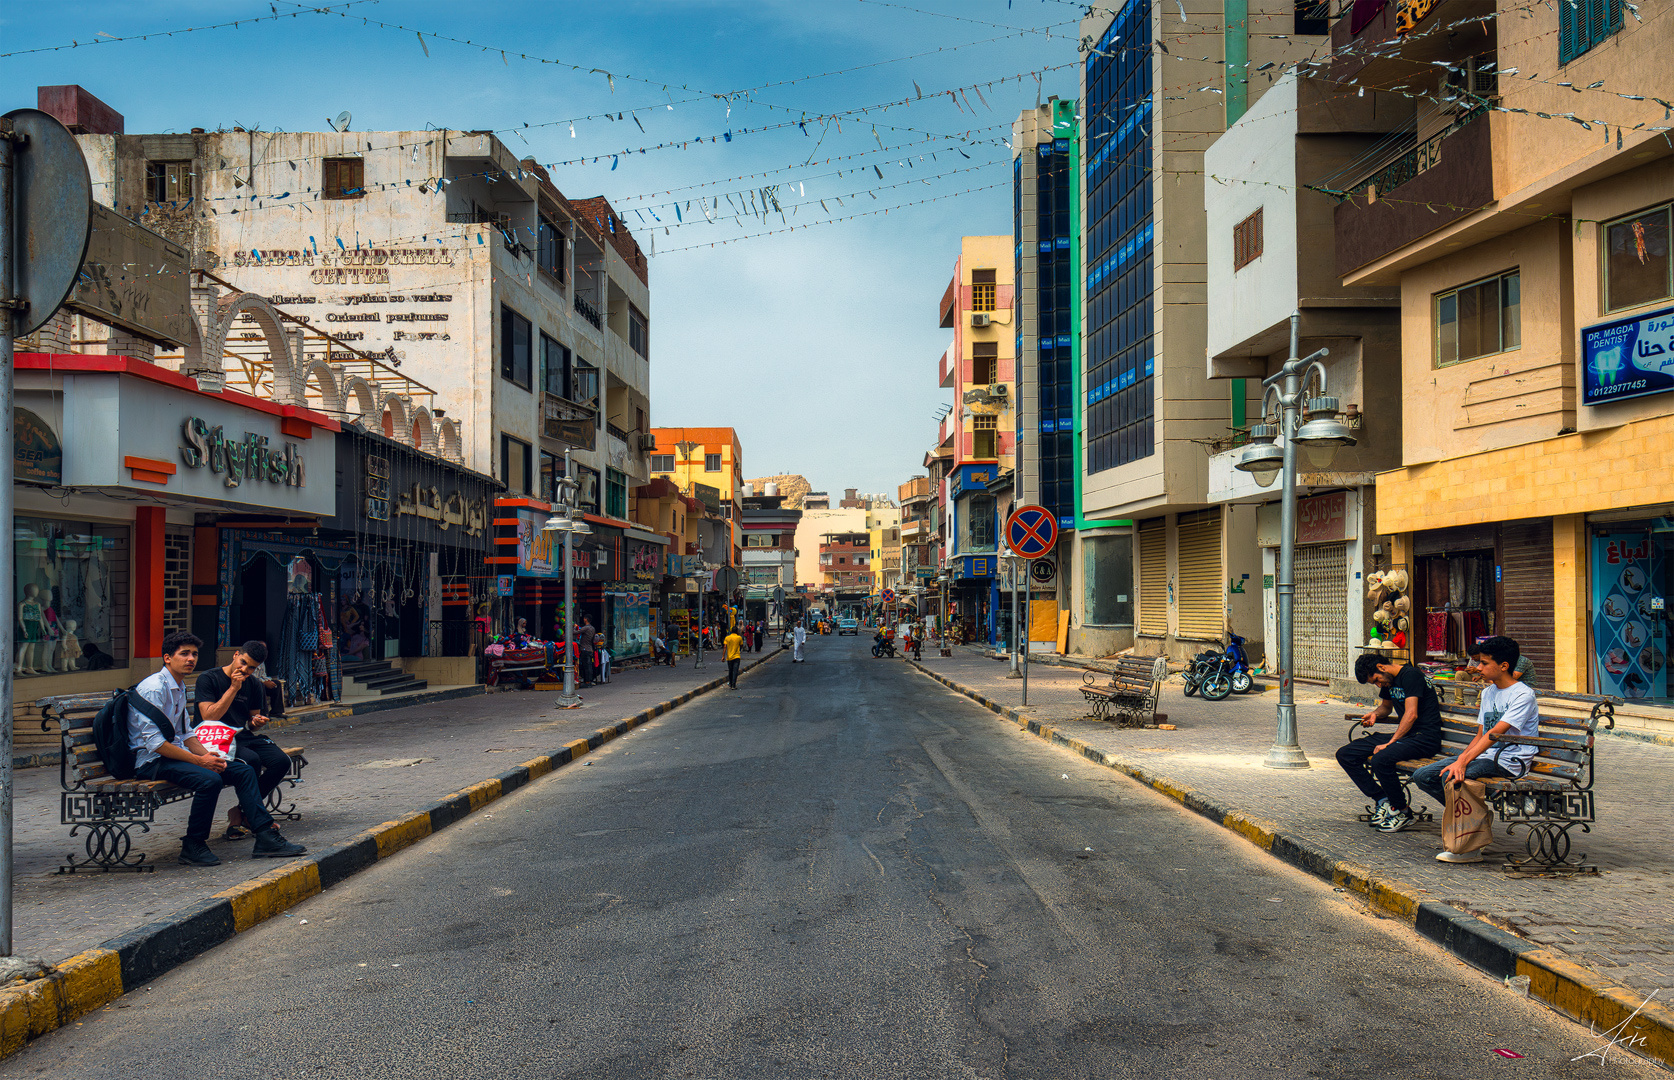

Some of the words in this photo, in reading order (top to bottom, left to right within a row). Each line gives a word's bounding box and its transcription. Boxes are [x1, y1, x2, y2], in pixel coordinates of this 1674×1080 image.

[233, 249, 315, 267] SANDRA
[320, 253, 332, 266] &
[309, 268, 390, 284] CENTER
[325, 312, 381, 323] Oriental
[385, 312, 449, 324] perfumes
[1588, 333, 1601, 342] DR.
[1603, 324, 1634, 337] MAGDA
[1593, 333, 1628, 349] DENTIST
[1637, 339, 1666, 358] حنا
[1593, 379, 1647, 396] 01229777452
[16, 448, 44, 462] SEA
[181, 416, 306, 488] Stylish
[26, 468, 46, 476] coffee
[1606, 540, 1656, 564] الدباغ
[571, 567, 590, 579] OKAR
[1034, 565, 1039, 575] C
[1039, 565, 1045, 575] &
[1046, 566, 1052, 575] A
